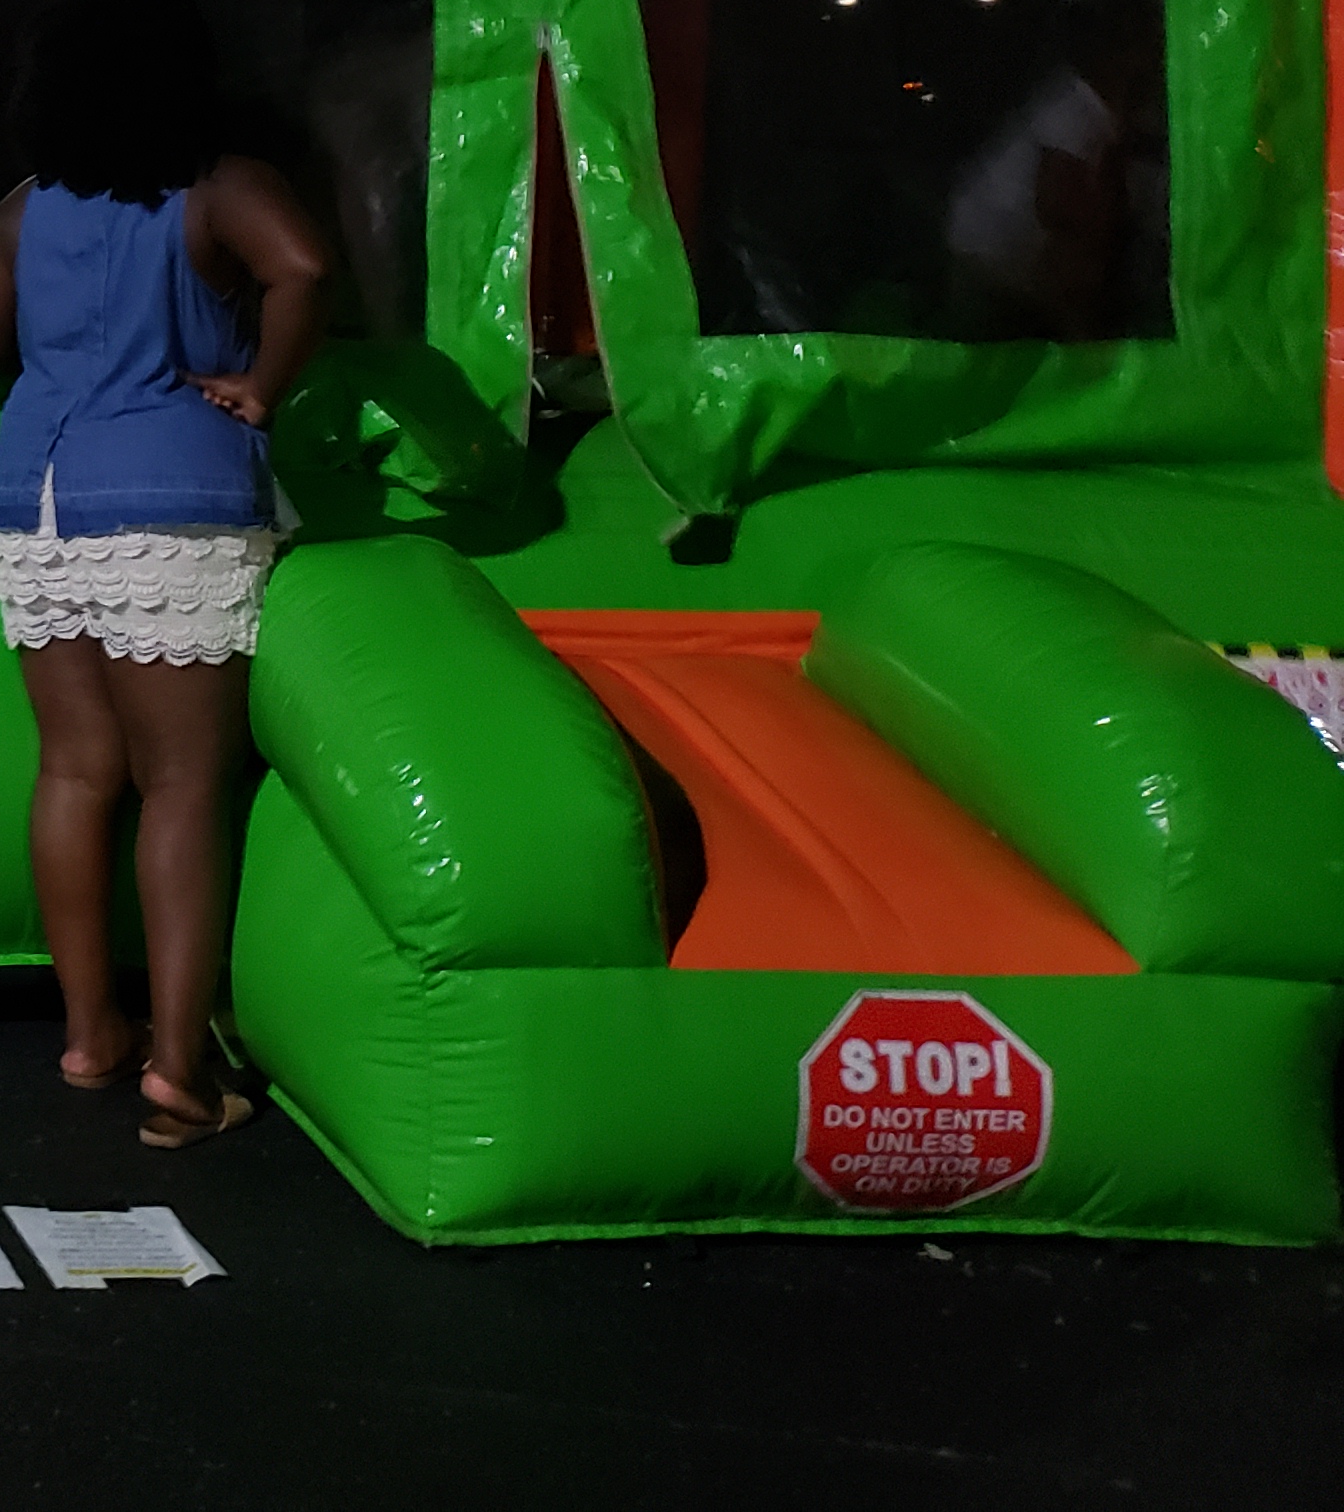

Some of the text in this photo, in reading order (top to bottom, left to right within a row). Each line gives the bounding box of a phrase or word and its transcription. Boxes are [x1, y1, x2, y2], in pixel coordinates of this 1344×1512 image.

[823, 1105, 1026, 1132] DO NOT ENTER
[866, 1132, 976, 1155] UNLESS
[830, 1153, 1012, 1175] OPERATOR IS
[855, 1175, 977, 1194] ON DUTY
